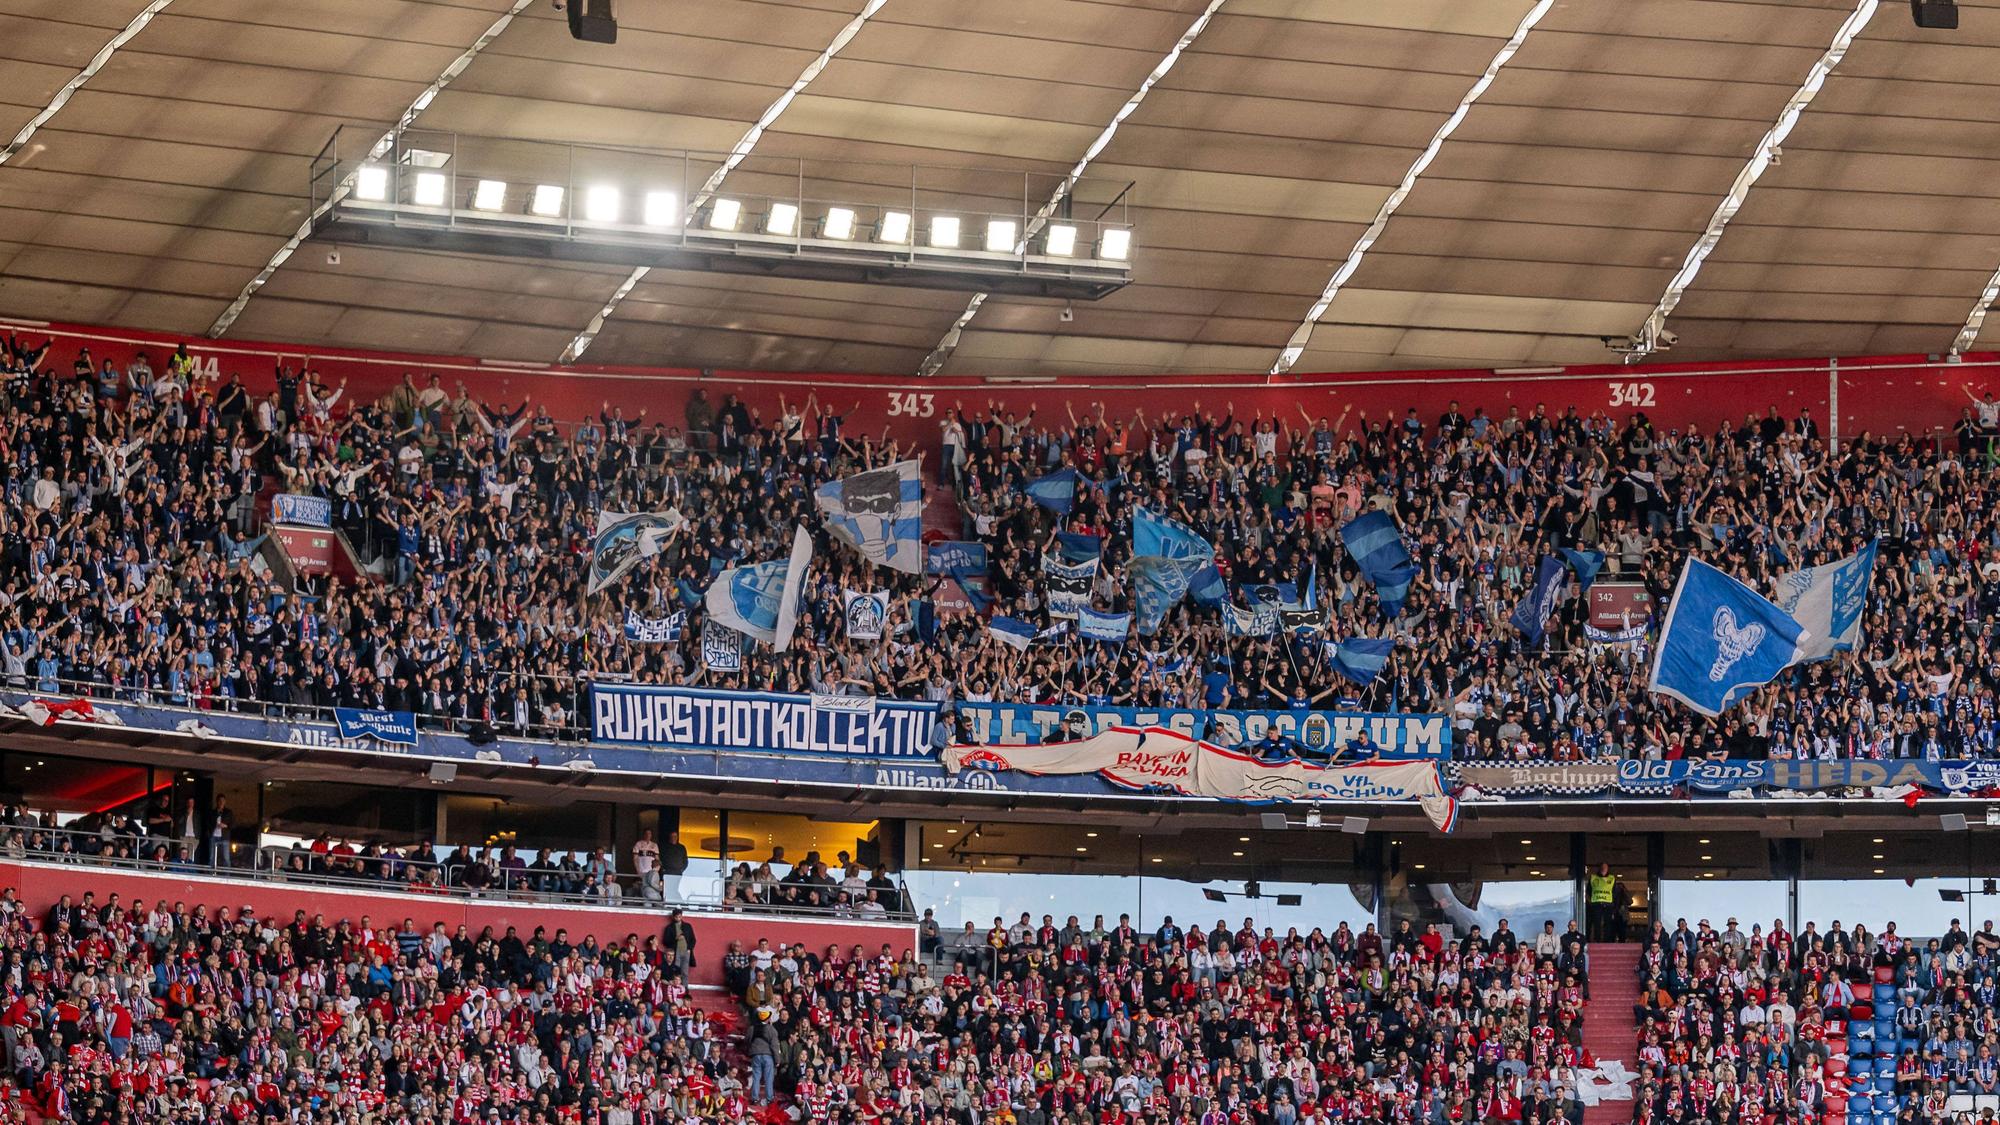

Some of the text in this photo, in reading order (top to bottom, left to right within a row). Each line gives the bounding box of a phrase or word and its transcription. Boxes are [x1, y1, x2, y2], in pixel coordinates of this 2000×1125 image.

[191, 355, 220, 382] 44
[1608, 383, 1656, 407] 342
[887, 392, 935, 417] 343
[309, 558, 327, 566] Arena
[1597, 593, 1613, 602] 342
[1598, 612, 1646, 620] Allianz Aren
[706, 634, 737, 652] RUHR
[706, 649, 738, 667] STADT
[358, 713, 394, 722] West
[1213, 713, 1443, 754] BOCHUM
[1620, 759, 1673, 780] Old
[1772, 762, 1932, 787] HEDA
[876, 769, 959, 789] Allianz
[1342, 774, 1374, 786] VfL
[1307, 781, 1404, 798] BOCHUM
